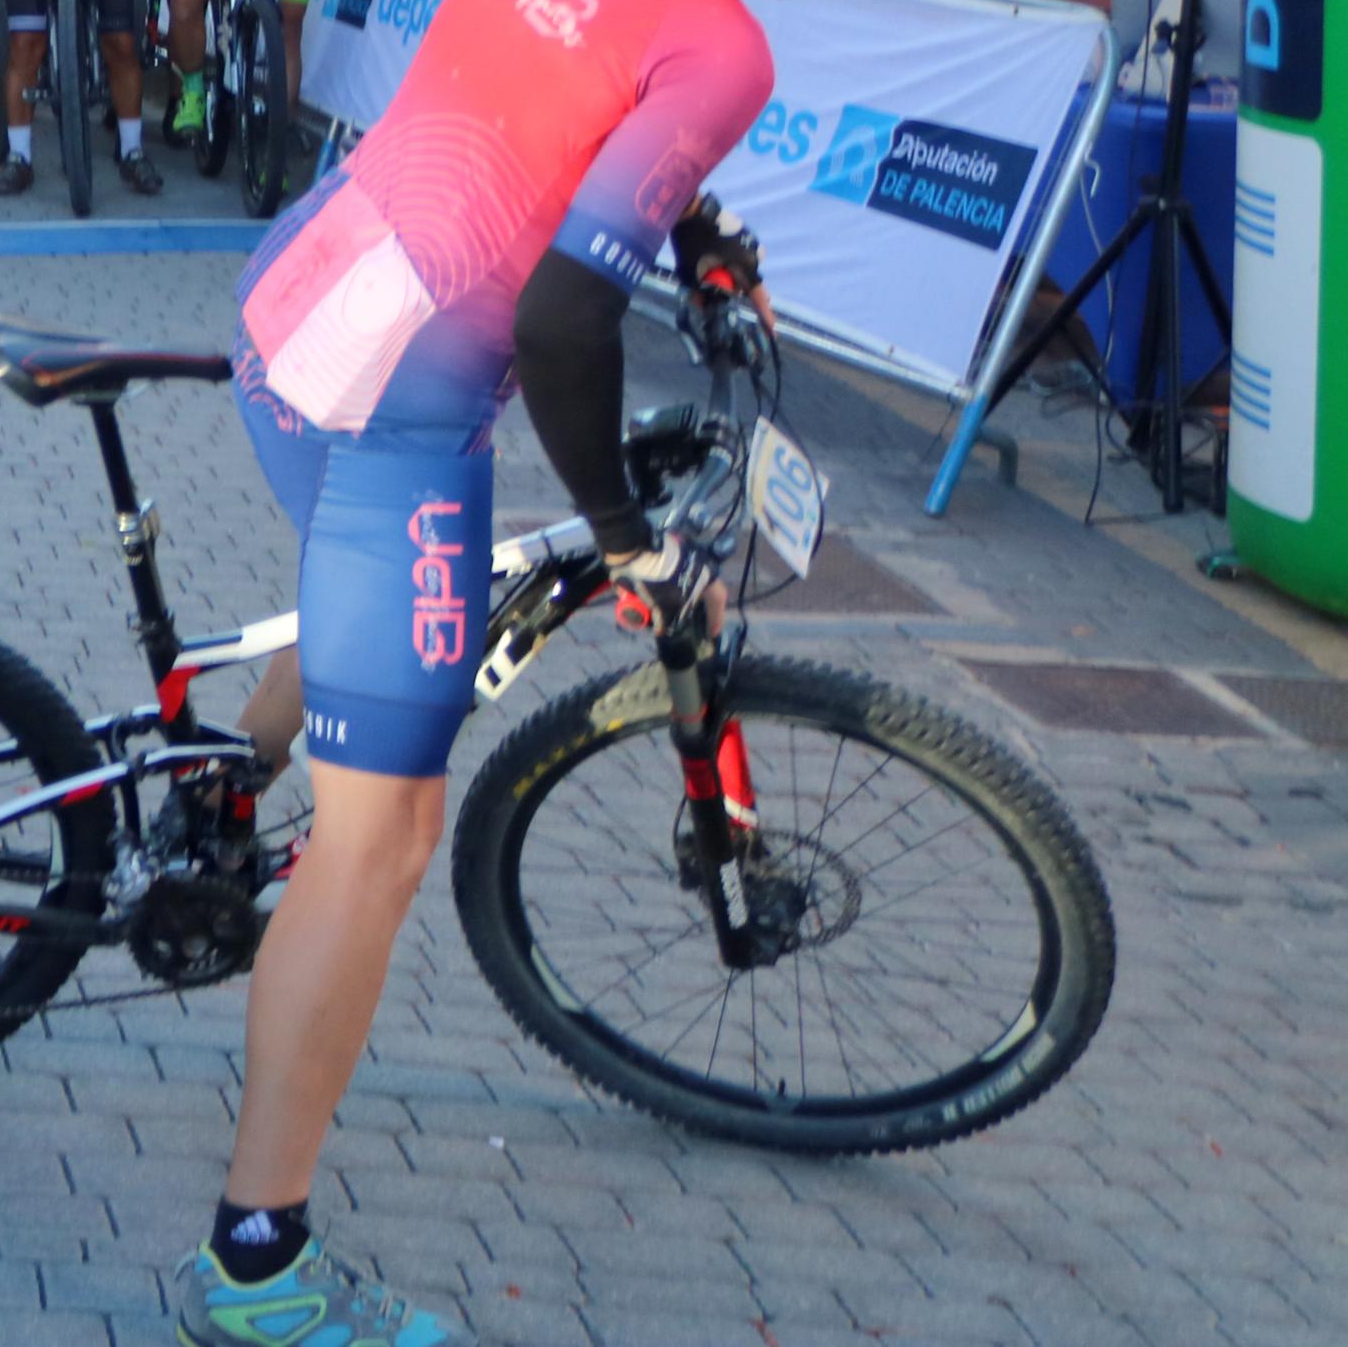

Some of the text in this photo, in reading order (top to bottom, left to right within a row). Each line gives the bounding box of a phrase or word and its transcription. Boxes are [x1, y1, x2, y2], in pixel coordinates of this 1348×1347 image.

[892, 132, 1000, 187] Diputación
[878, 168, 1007, 234] DE PALENCIA
[762, 446, 814, 547] 106
